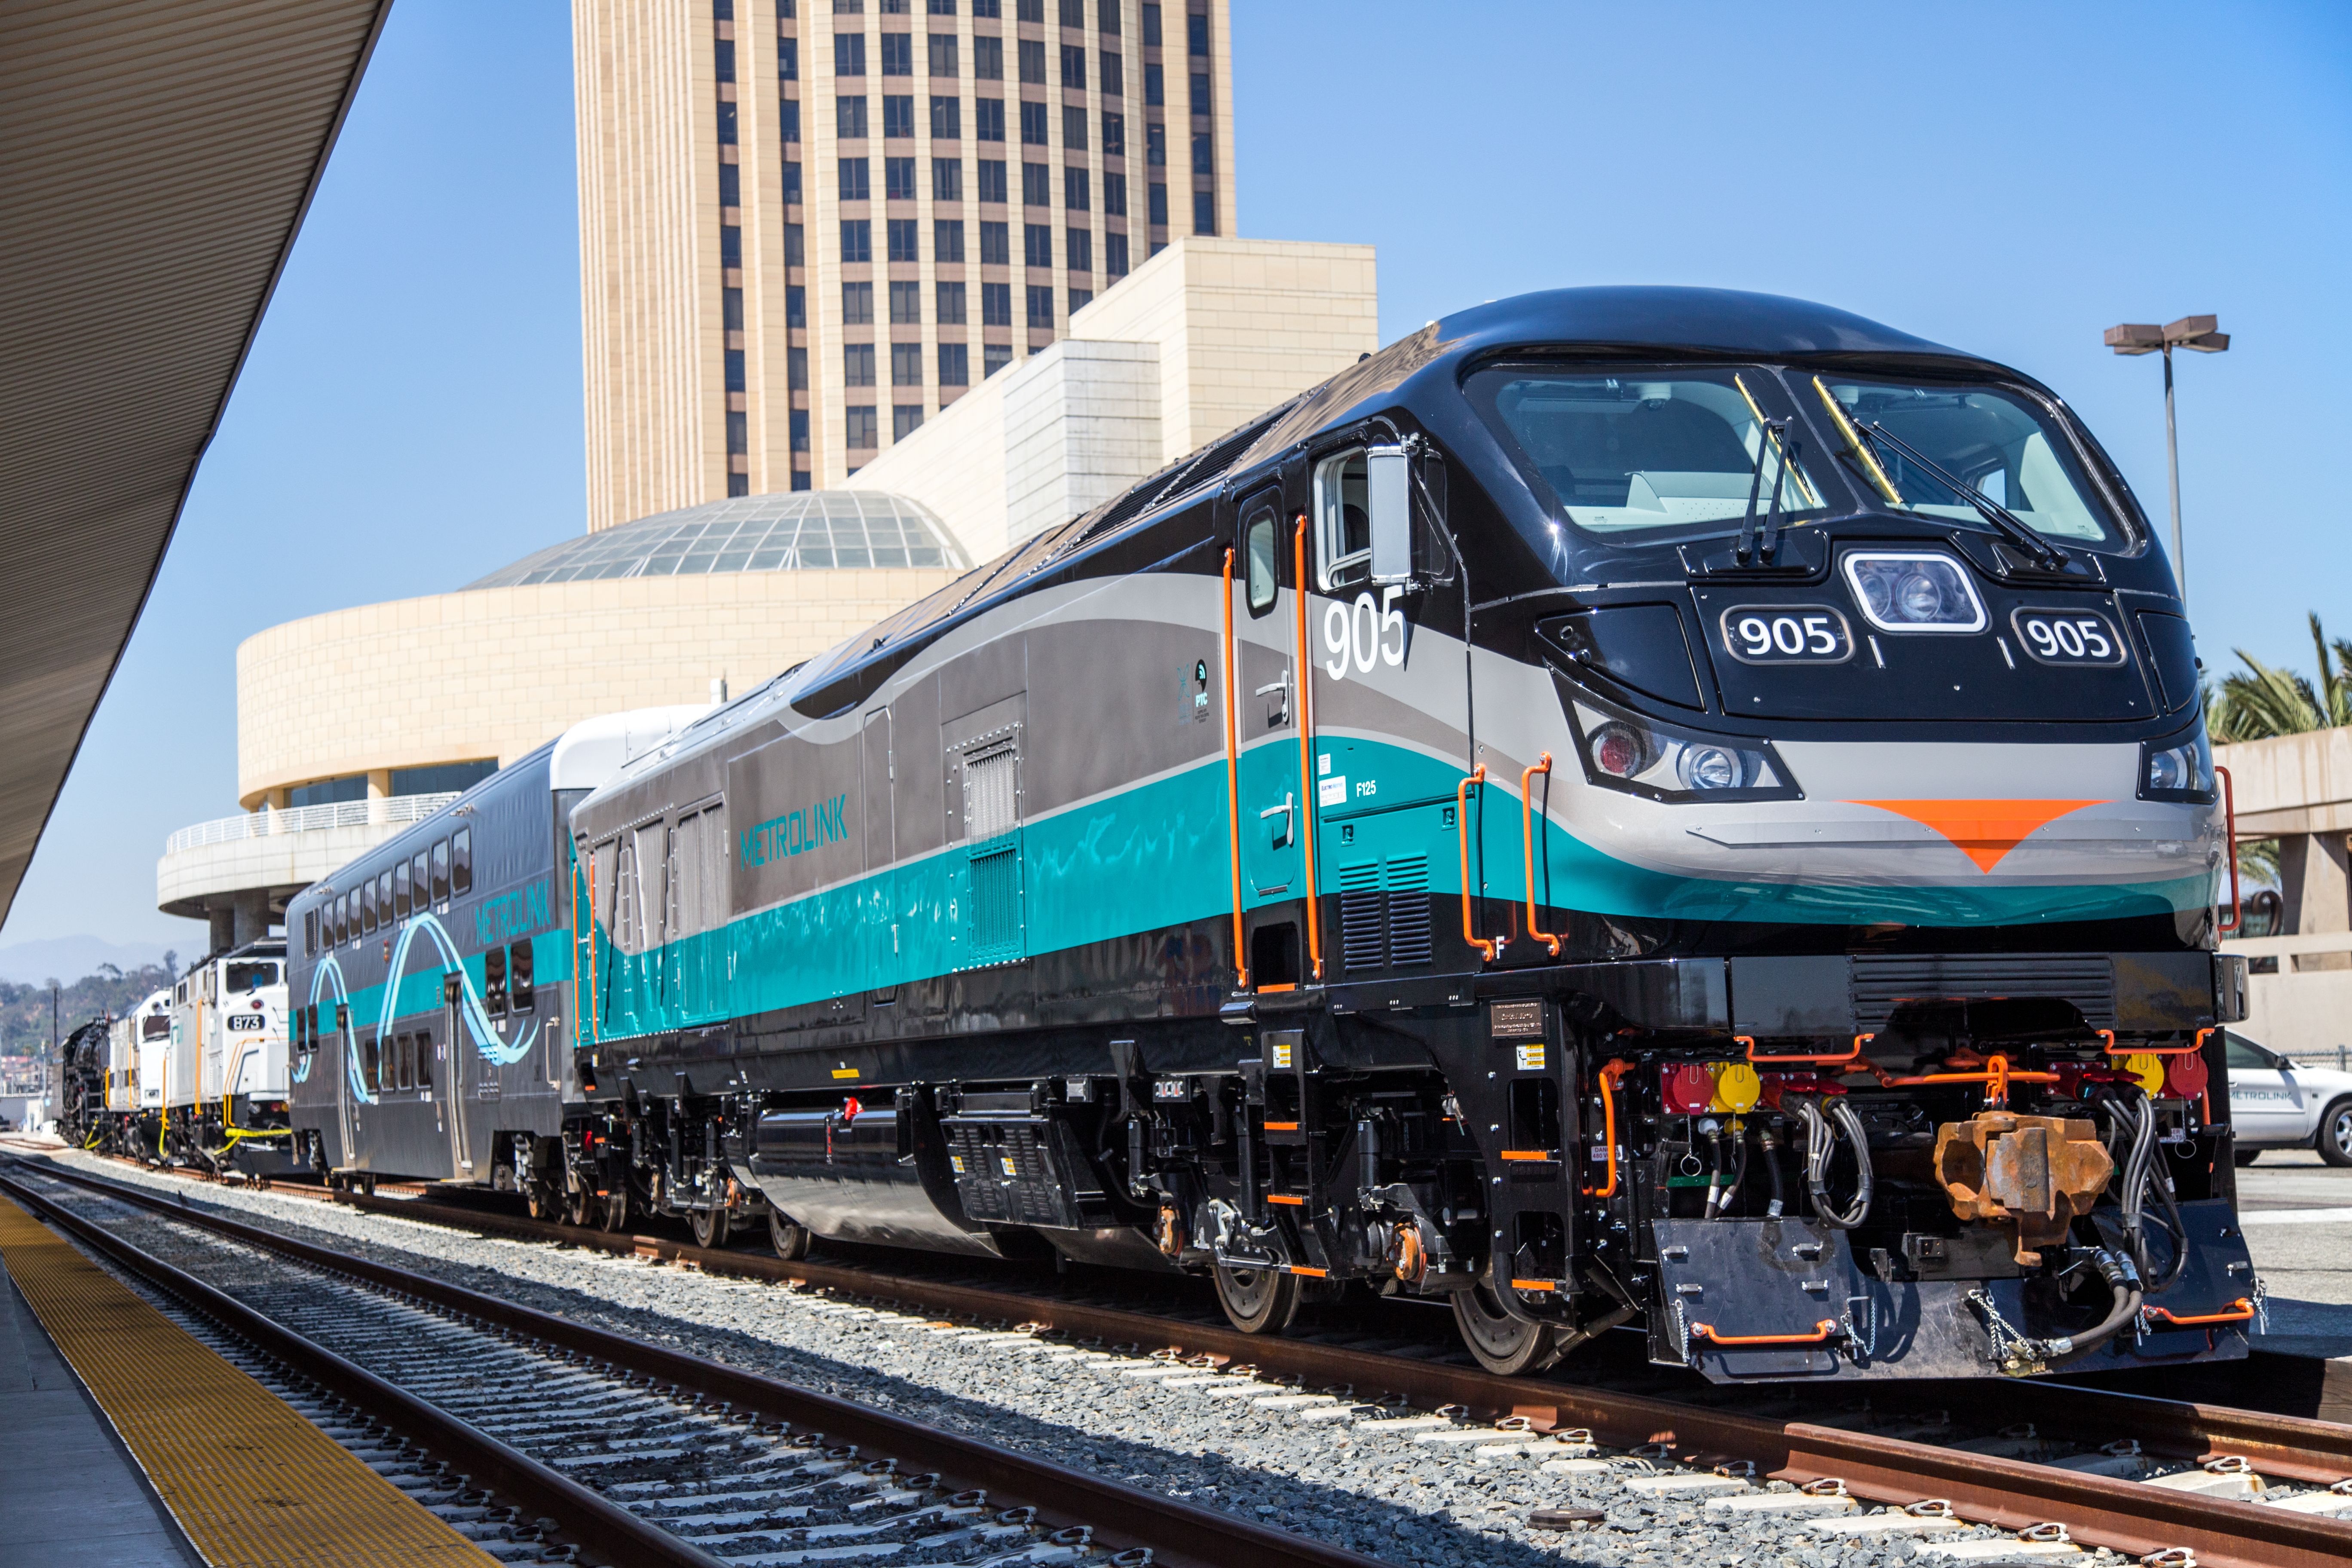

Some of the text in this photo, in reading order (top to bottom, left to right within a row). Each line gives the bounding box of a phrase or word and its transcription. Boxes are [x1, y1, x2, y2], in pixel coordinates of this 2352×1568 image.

[1323, 585, 1408, 680] 905
[1739, 618, 1836, 655] 905
[2027, 619, 2110, 657] 905
[1195, 692, 1208, 707] PTC
[1357, 780, 1376, 797] F125
[740, 794, 848, 871] METROLINK
[476, 879, 551, 947] METROLINK
[1496, 936, 1504, 959] F
[233, 1016, 260, 1030] 873
